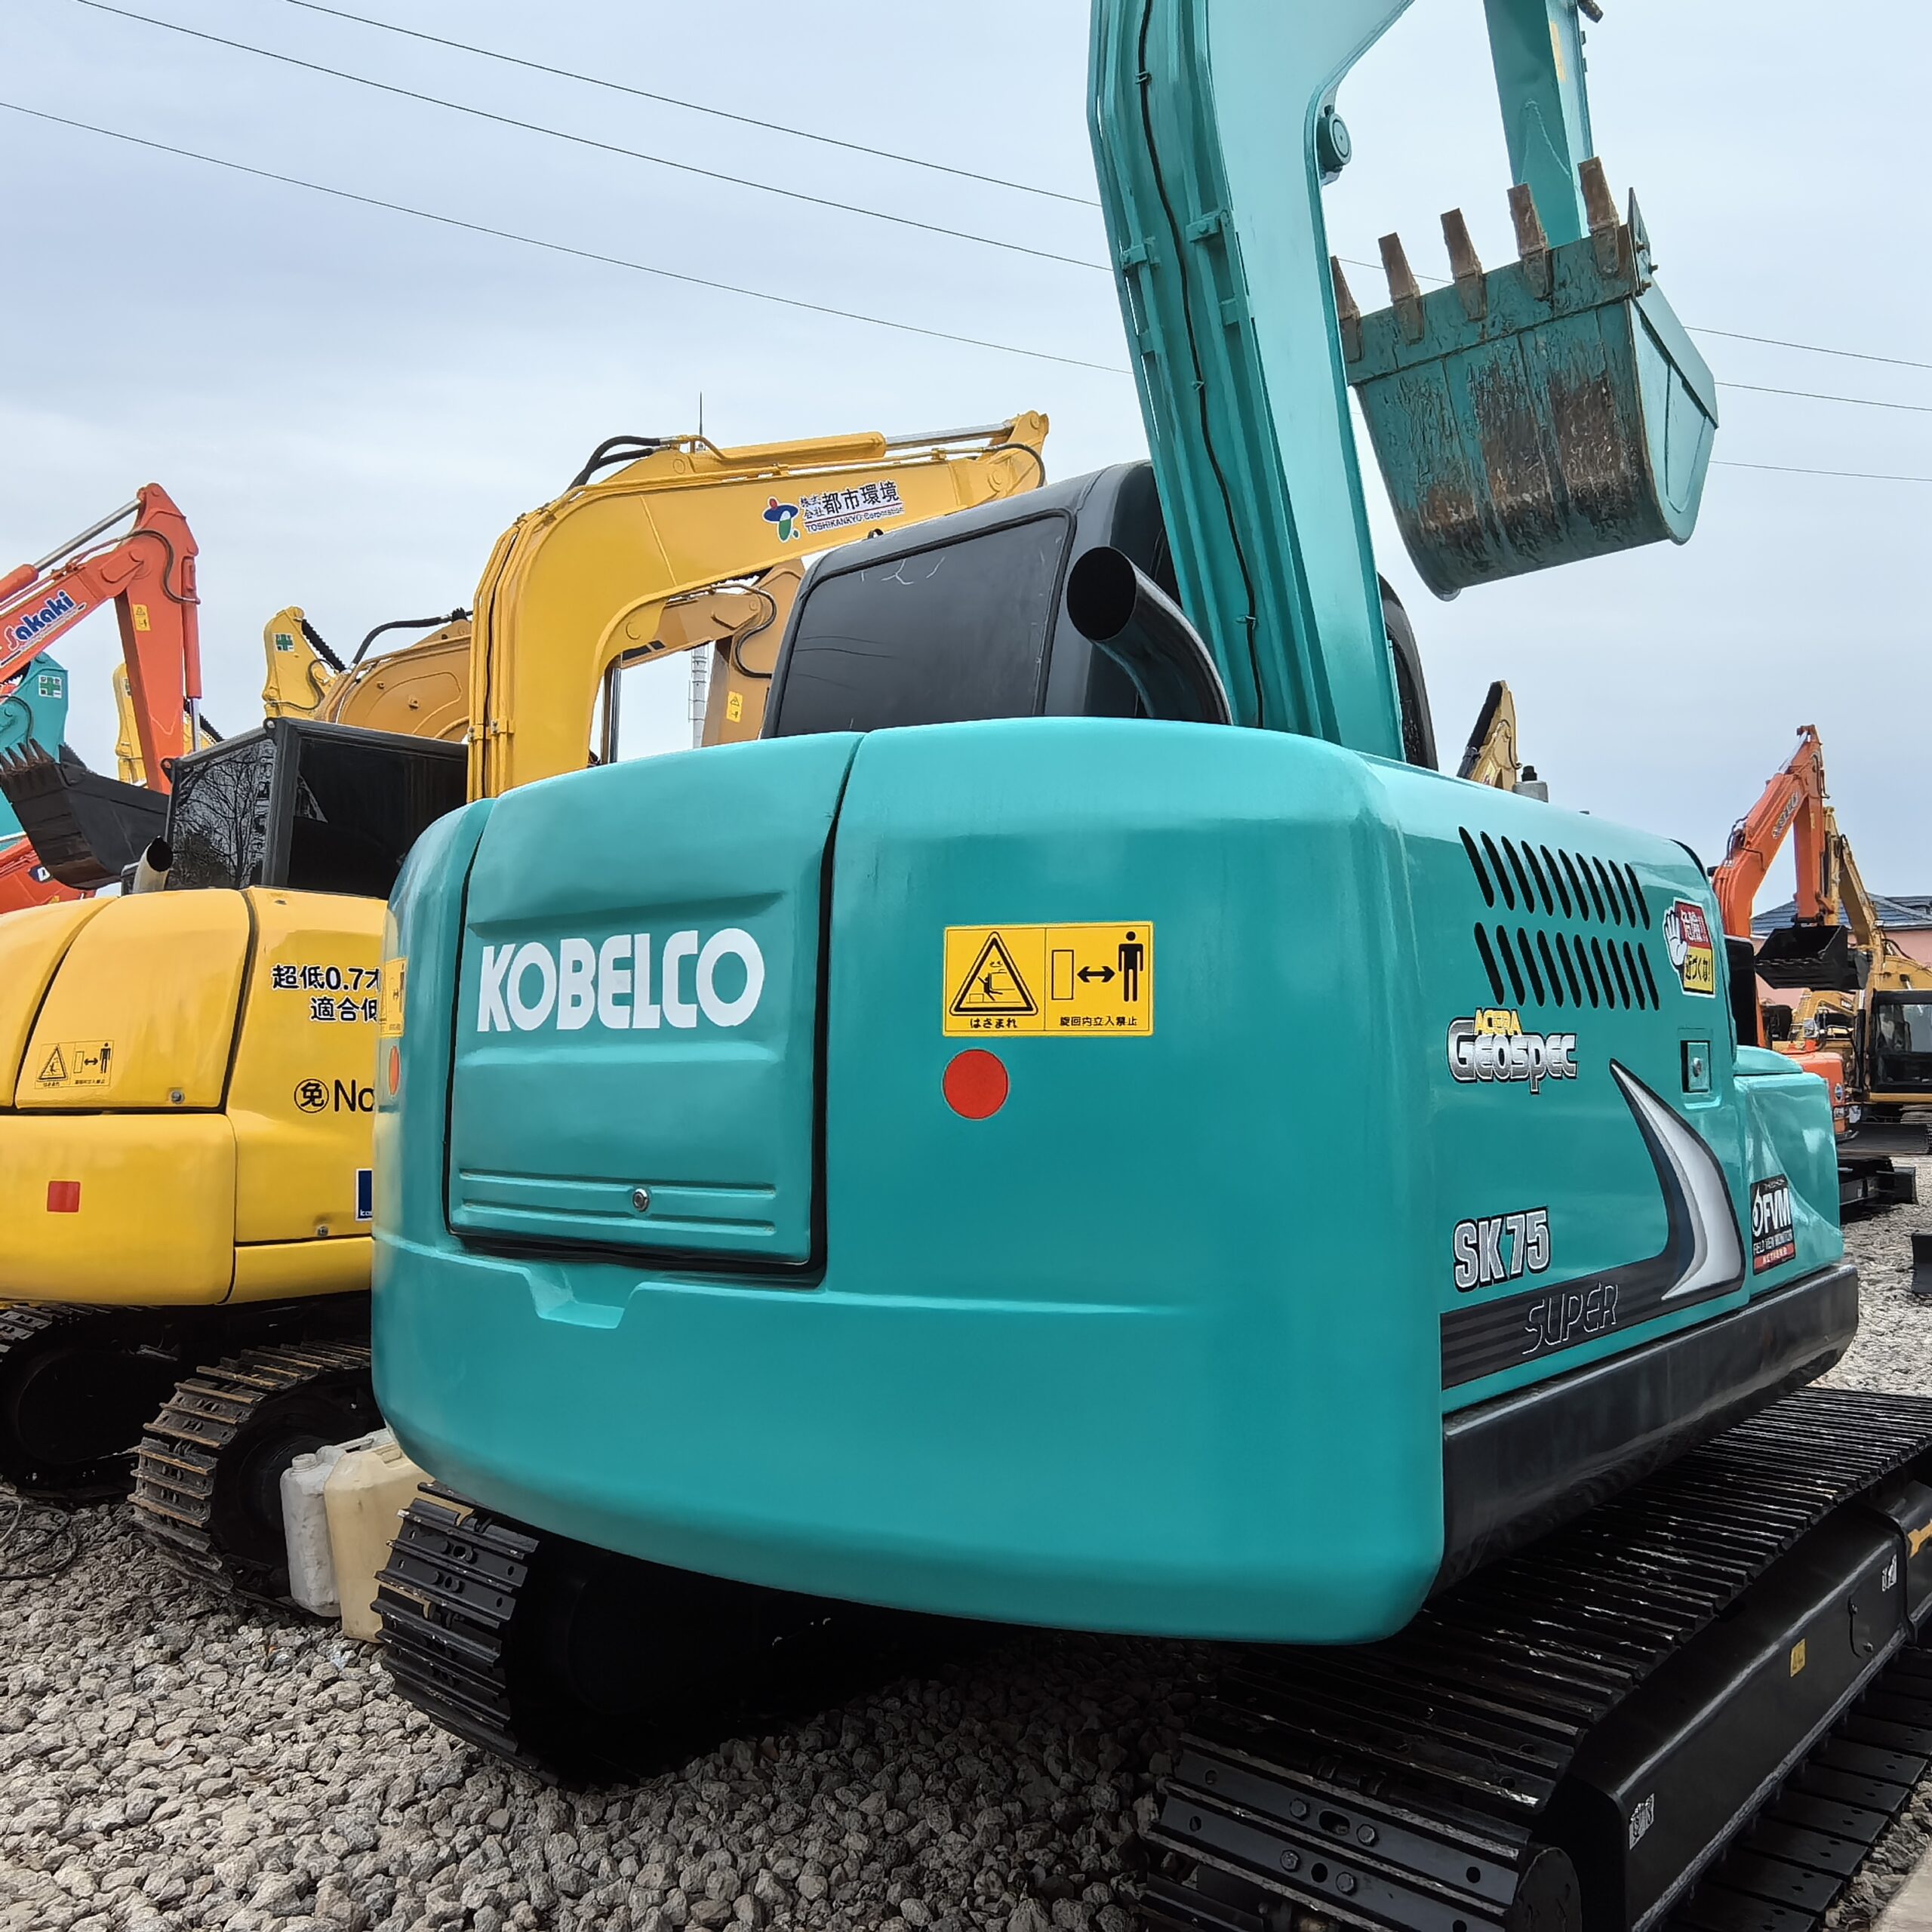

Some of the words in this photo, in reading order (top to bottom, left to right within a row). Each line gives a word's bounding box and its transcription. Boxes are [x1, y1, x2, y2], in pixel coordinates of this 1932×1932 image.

[823, 480, 900, 515] 都市環境
[4, 590, 76, 651] Sakaki
[477, 928, 764, 1032] KOBELCO
[970, 1017, 1017, 1029] はさまれ
[1521, 1282, 1619, 1355] SUPER
